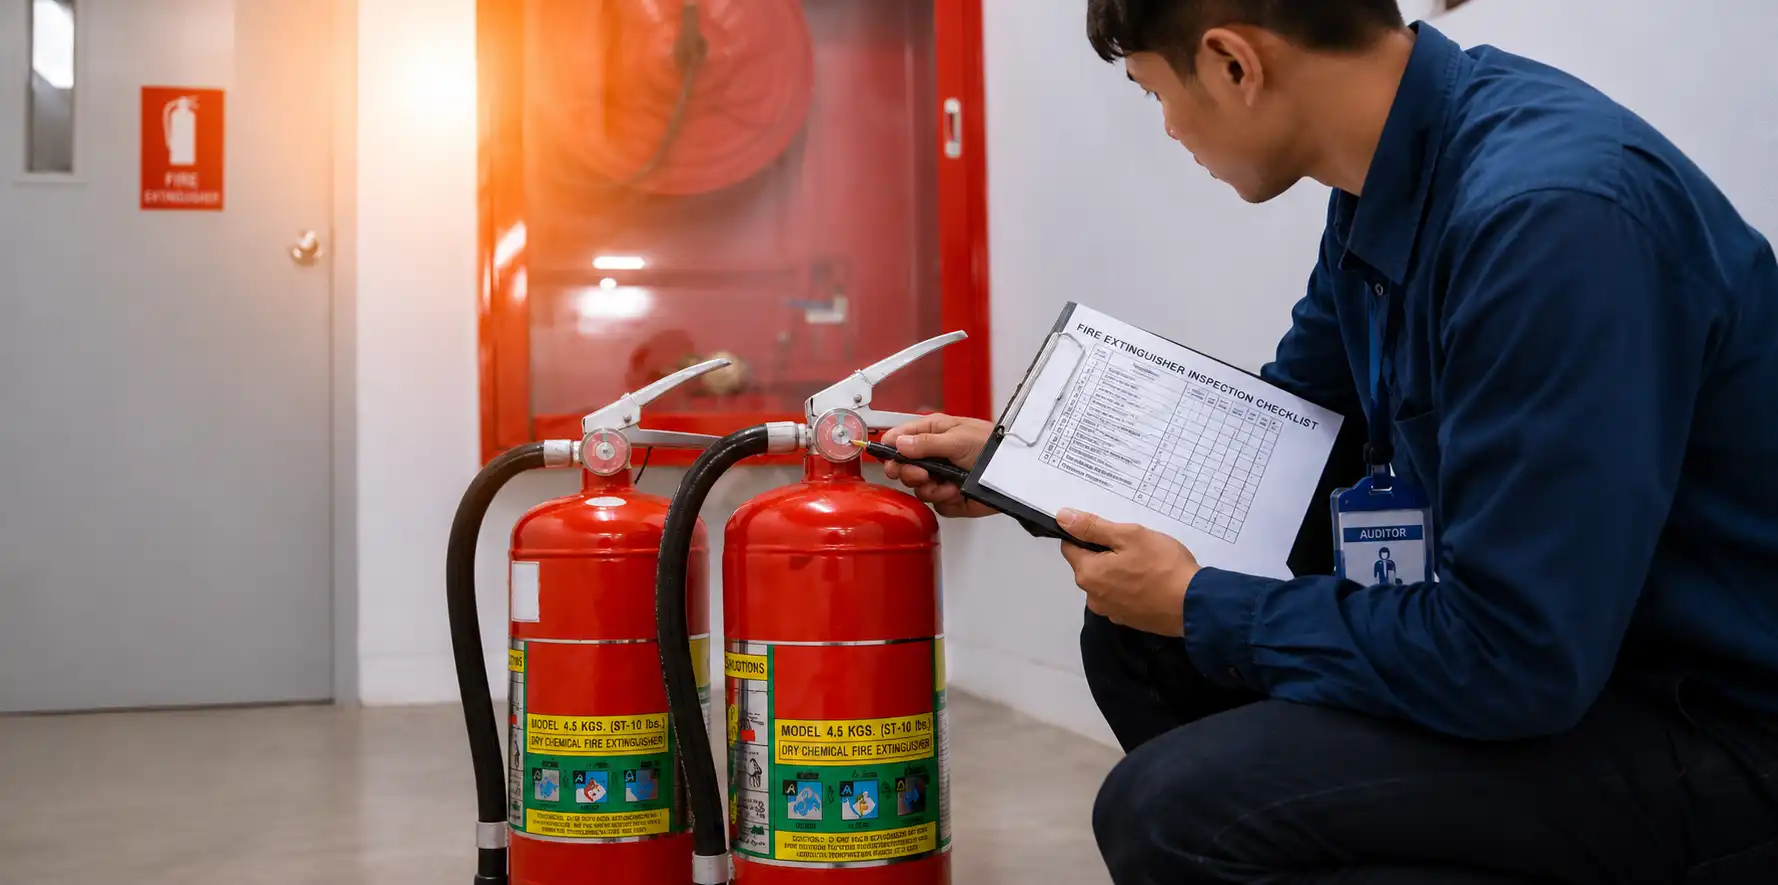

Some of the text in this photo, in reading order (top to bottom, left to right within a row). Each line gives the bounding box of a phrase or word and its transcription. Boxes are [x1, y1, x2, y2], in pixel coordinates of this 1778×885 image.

[164, 172, 199, 189] FIRE
[1076, 323, 1102, 340] FIRE
[1104, 335, 1185, 375] EXTINGUISHER
[1187, 369, 1254, 404] INSPECTION
[1255, 398, 1320, 430] CHECKLIST
[1360, 528, 1407, 540] AUDITOR
[531, 718, 666, 733] MODEL 4.5 KGS. (ST-10 lbs.)
[781, 725, 821, 738] MODEL
[826, 726, 843, 738] 4.5
[848, 725, 876, 737] KGS.
[880, 722, 912, 737] (ST-10
[531, 735, 543, 746] DRY
[584, 738, 603, 748] FIRE
[781, 745, 800, 756] DRY
[802, 746, 848, 757] CHEMICAL
[852, 745, 873, 756] FIRE
